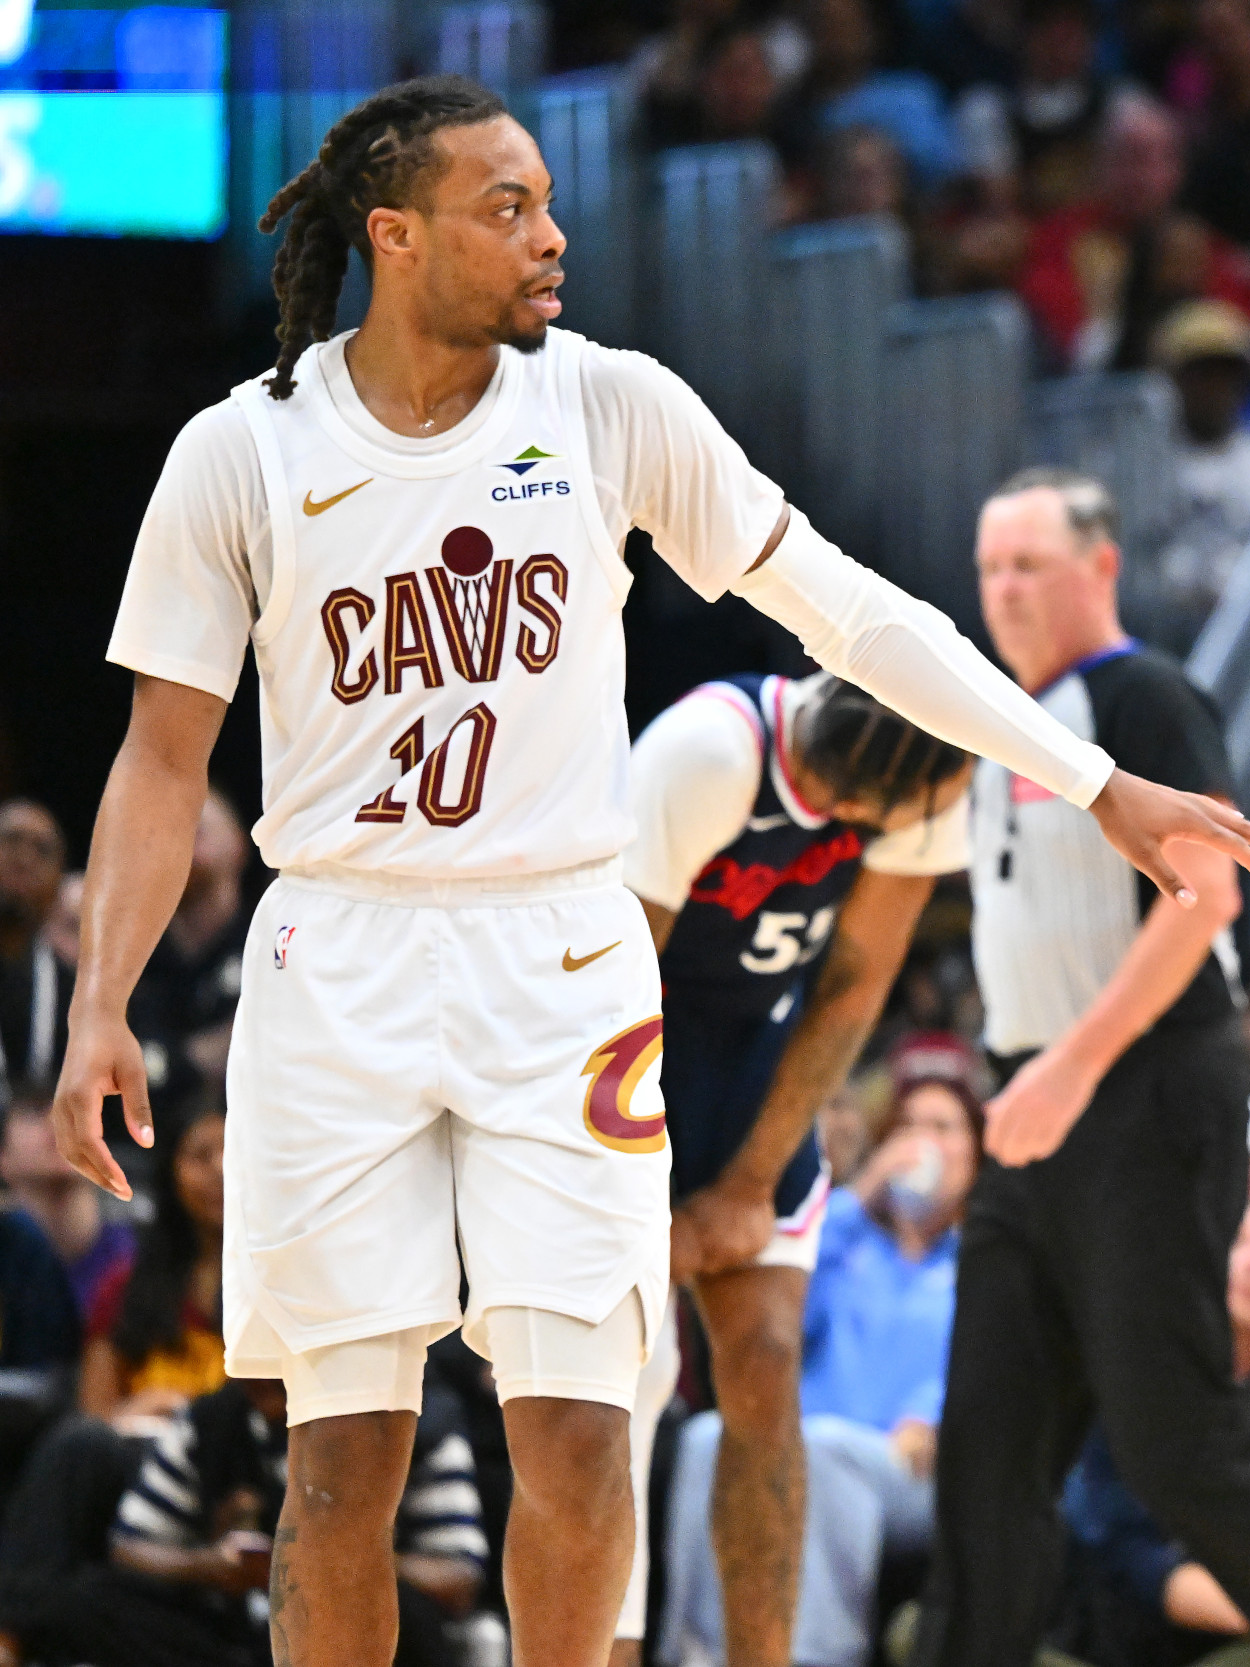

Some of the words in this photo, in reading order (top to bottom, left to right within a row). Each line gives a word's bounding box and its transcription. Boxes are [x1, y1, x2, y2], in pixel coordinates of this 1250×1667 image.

[491, 480, 570, 502] CLIFFS
[321, 553, 568, 705] CAVS
[354, 701, 497, 828] 10
